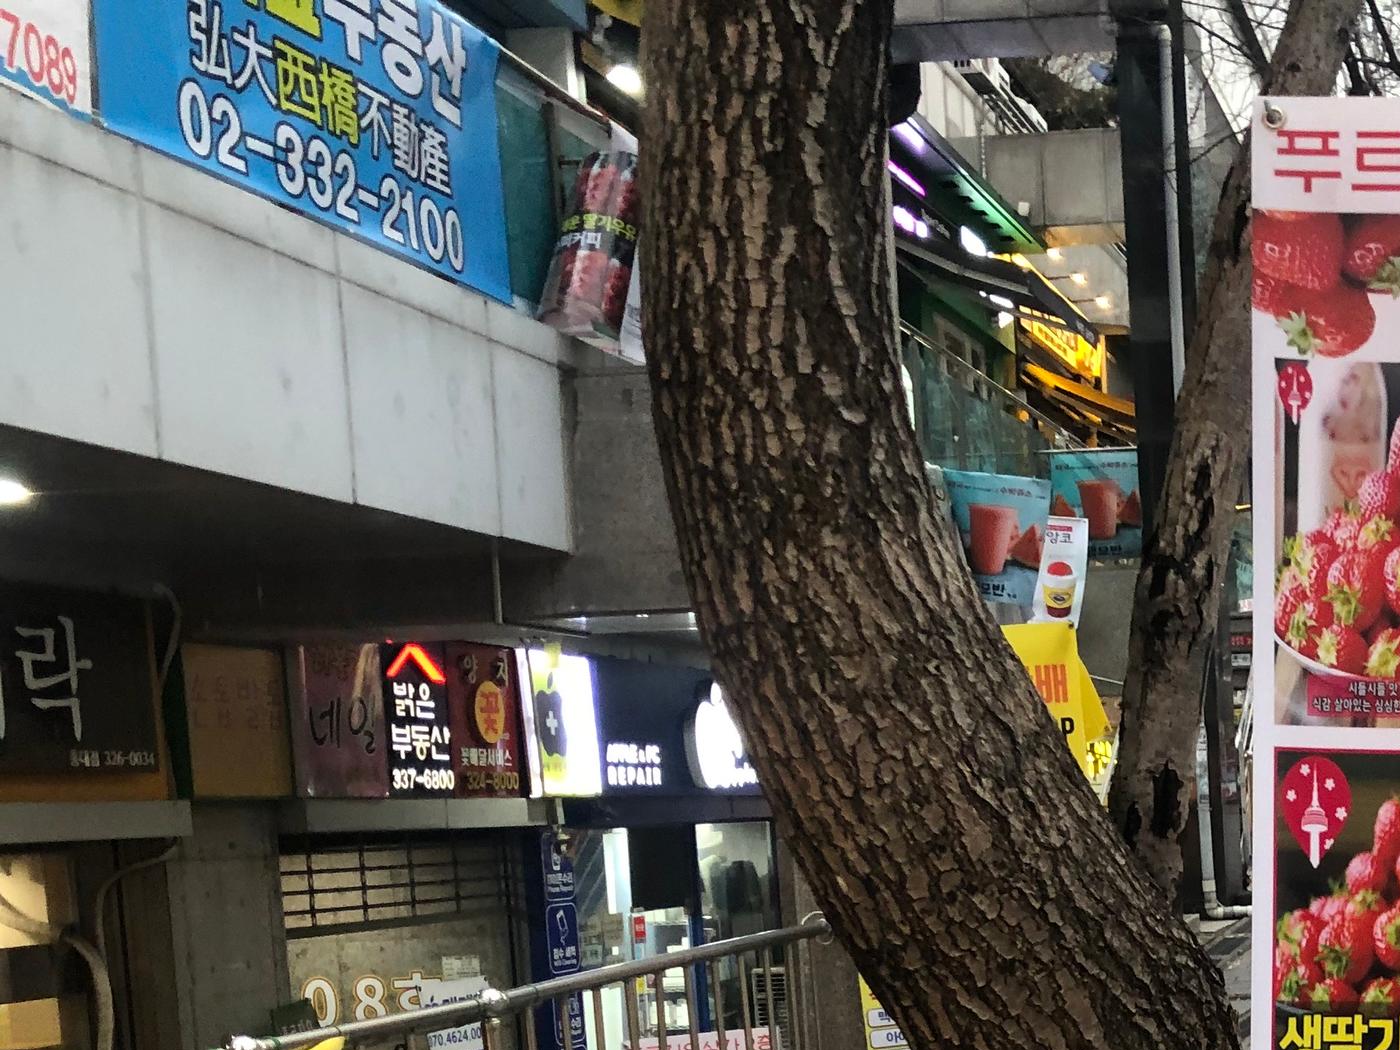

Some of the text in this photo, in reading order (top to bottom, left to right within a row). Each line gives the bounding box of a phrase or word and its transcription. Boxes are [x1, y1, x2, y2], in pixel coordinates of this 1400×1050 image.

[178, 80, 464, 273] 02-332-2100
[0, 615, 93, 742] 락
[393, 682, 436, 720] 밝은
[1312, 699, 1331, 713] 식감
[1334, 699, 1372, 713] 살아있는
[309, 697, 376, 754] 네일
[391, 724, 451, 761] 부동산
[392, 769, 455, 791] 337-6800
[466, 772, 520, 791] 324-8000
[607, 765, 662, 786] REPAIR
